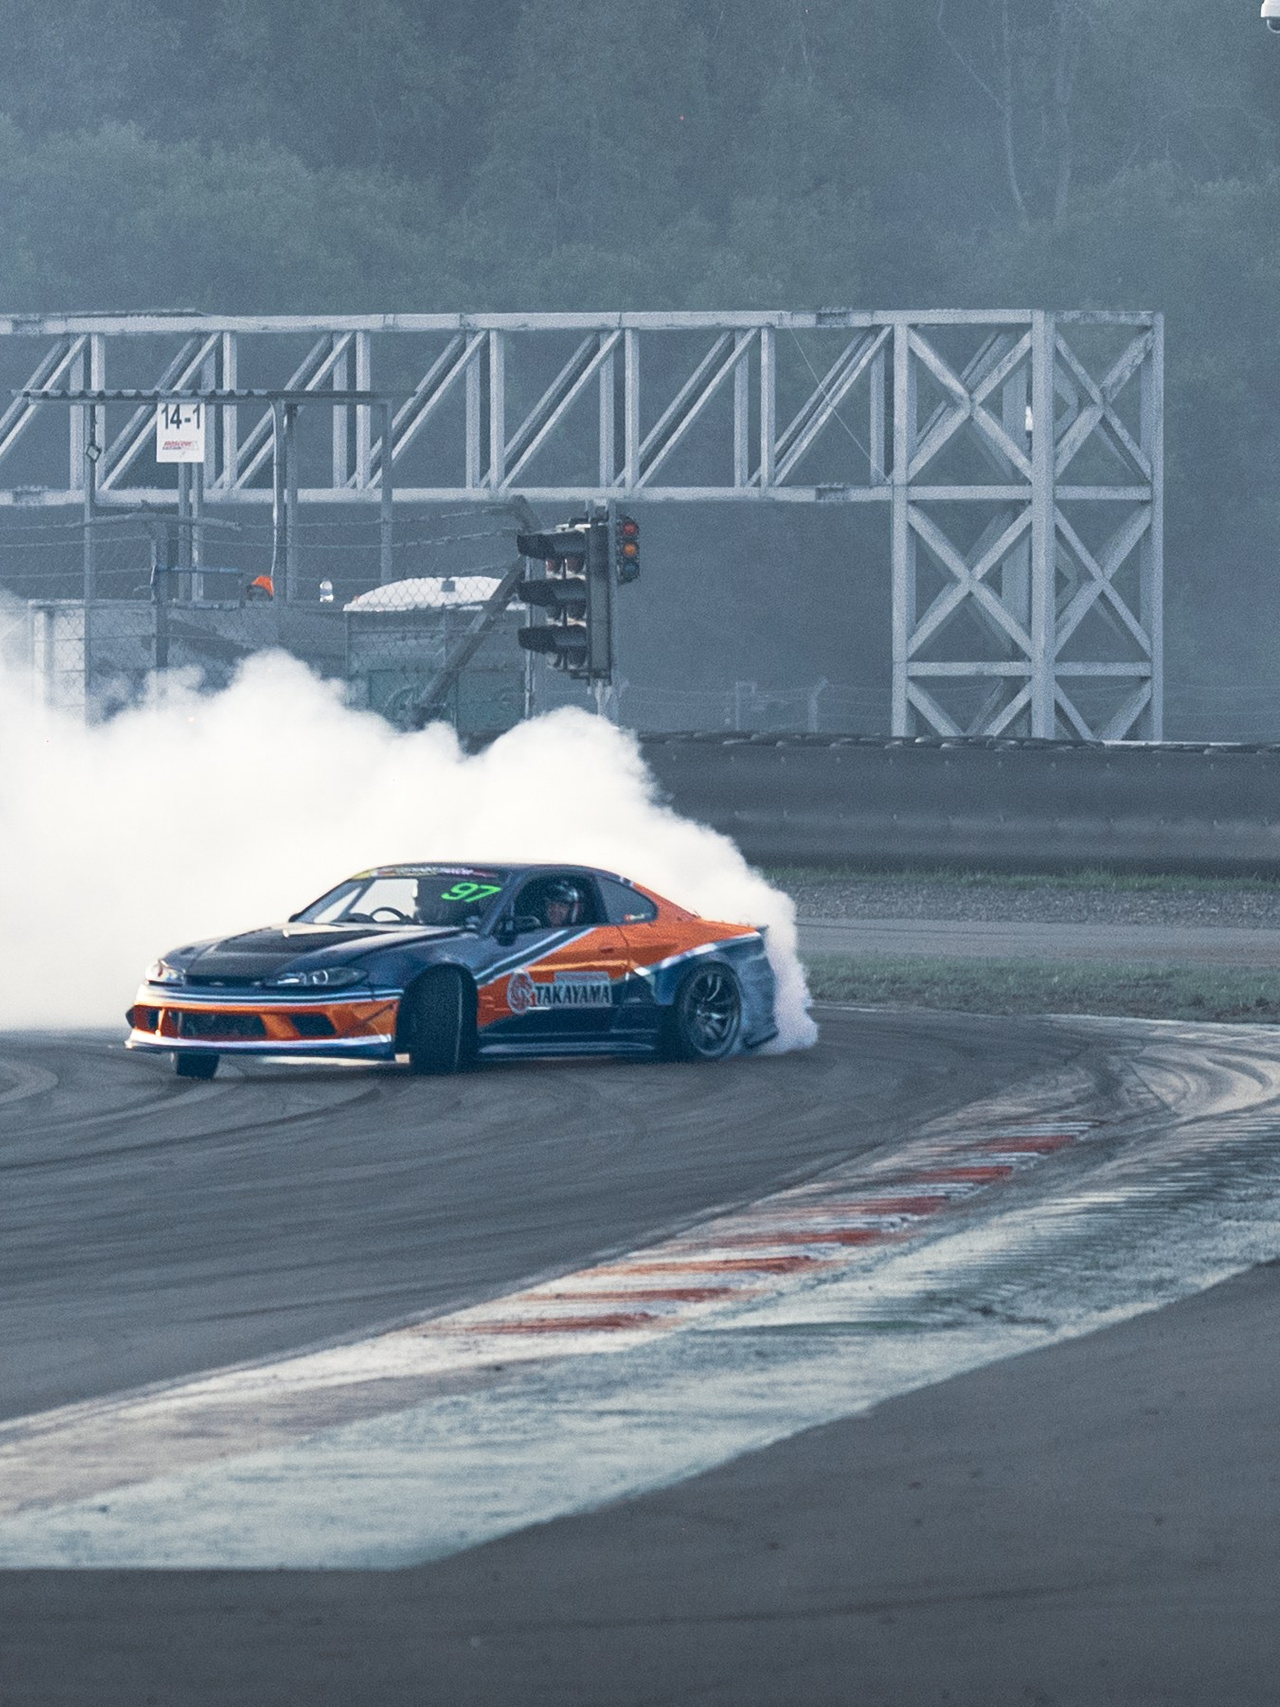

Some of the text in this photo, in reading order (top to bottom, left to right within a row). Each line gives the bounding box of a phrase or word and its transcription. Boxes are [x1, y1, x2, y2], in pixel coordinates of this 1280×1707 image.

[160, 403, 201, 430] 14-1
[441, 882, 502, 902] 97
[535, 984, 610, 1004] TAKAYAMA
